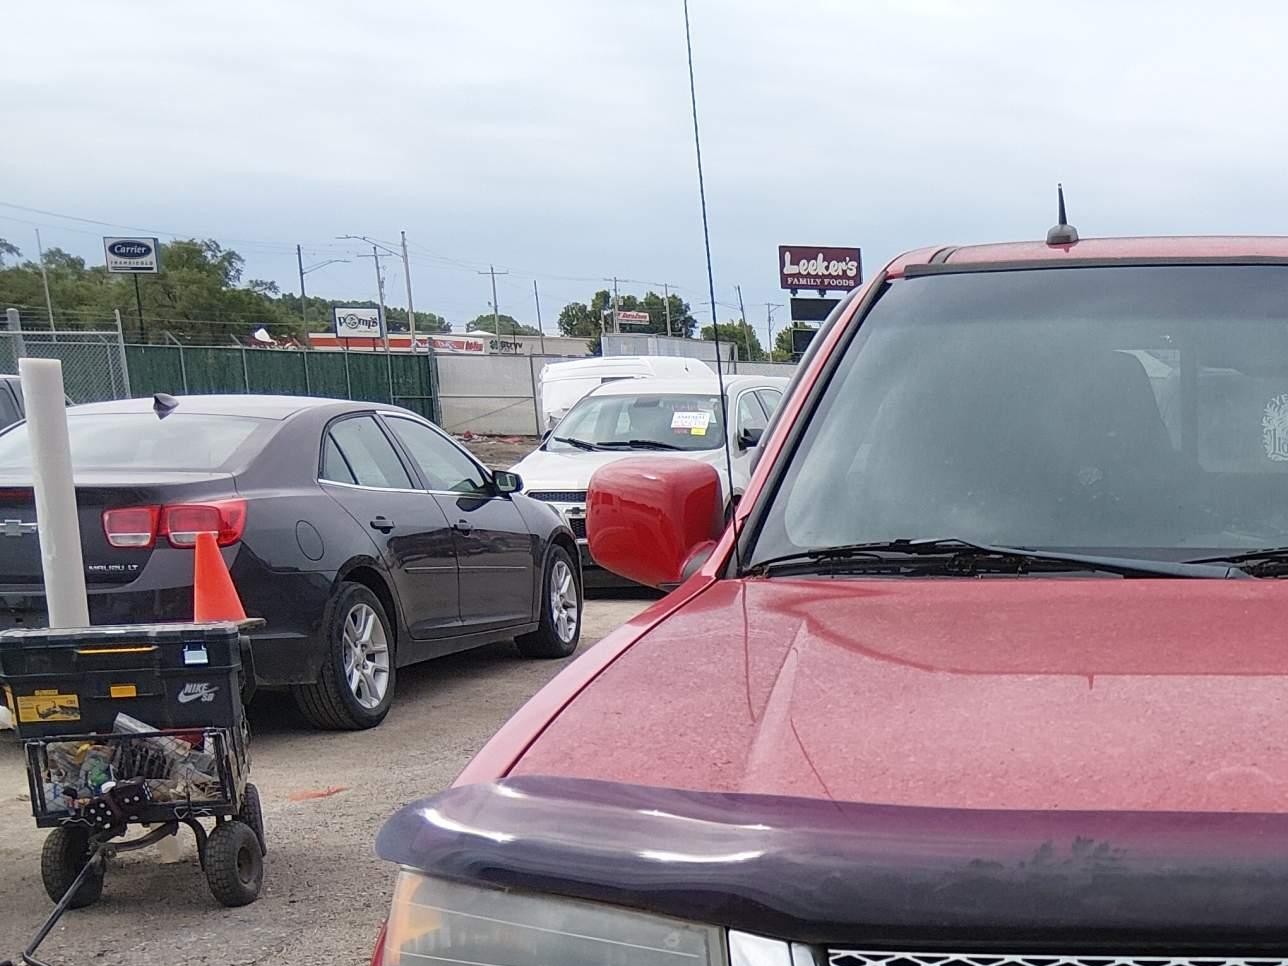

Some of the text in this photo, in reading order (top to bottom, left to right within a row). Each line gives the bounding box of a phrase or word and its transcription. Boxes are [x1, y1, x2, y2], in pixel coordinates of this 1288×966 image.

[114, 245, 146, 254] Carrier
[783, 251, 858, 277] Leeker's
[787, 278, 855, 287] FAMILY FOODS
[184, 682, 209, 694] NIKE
